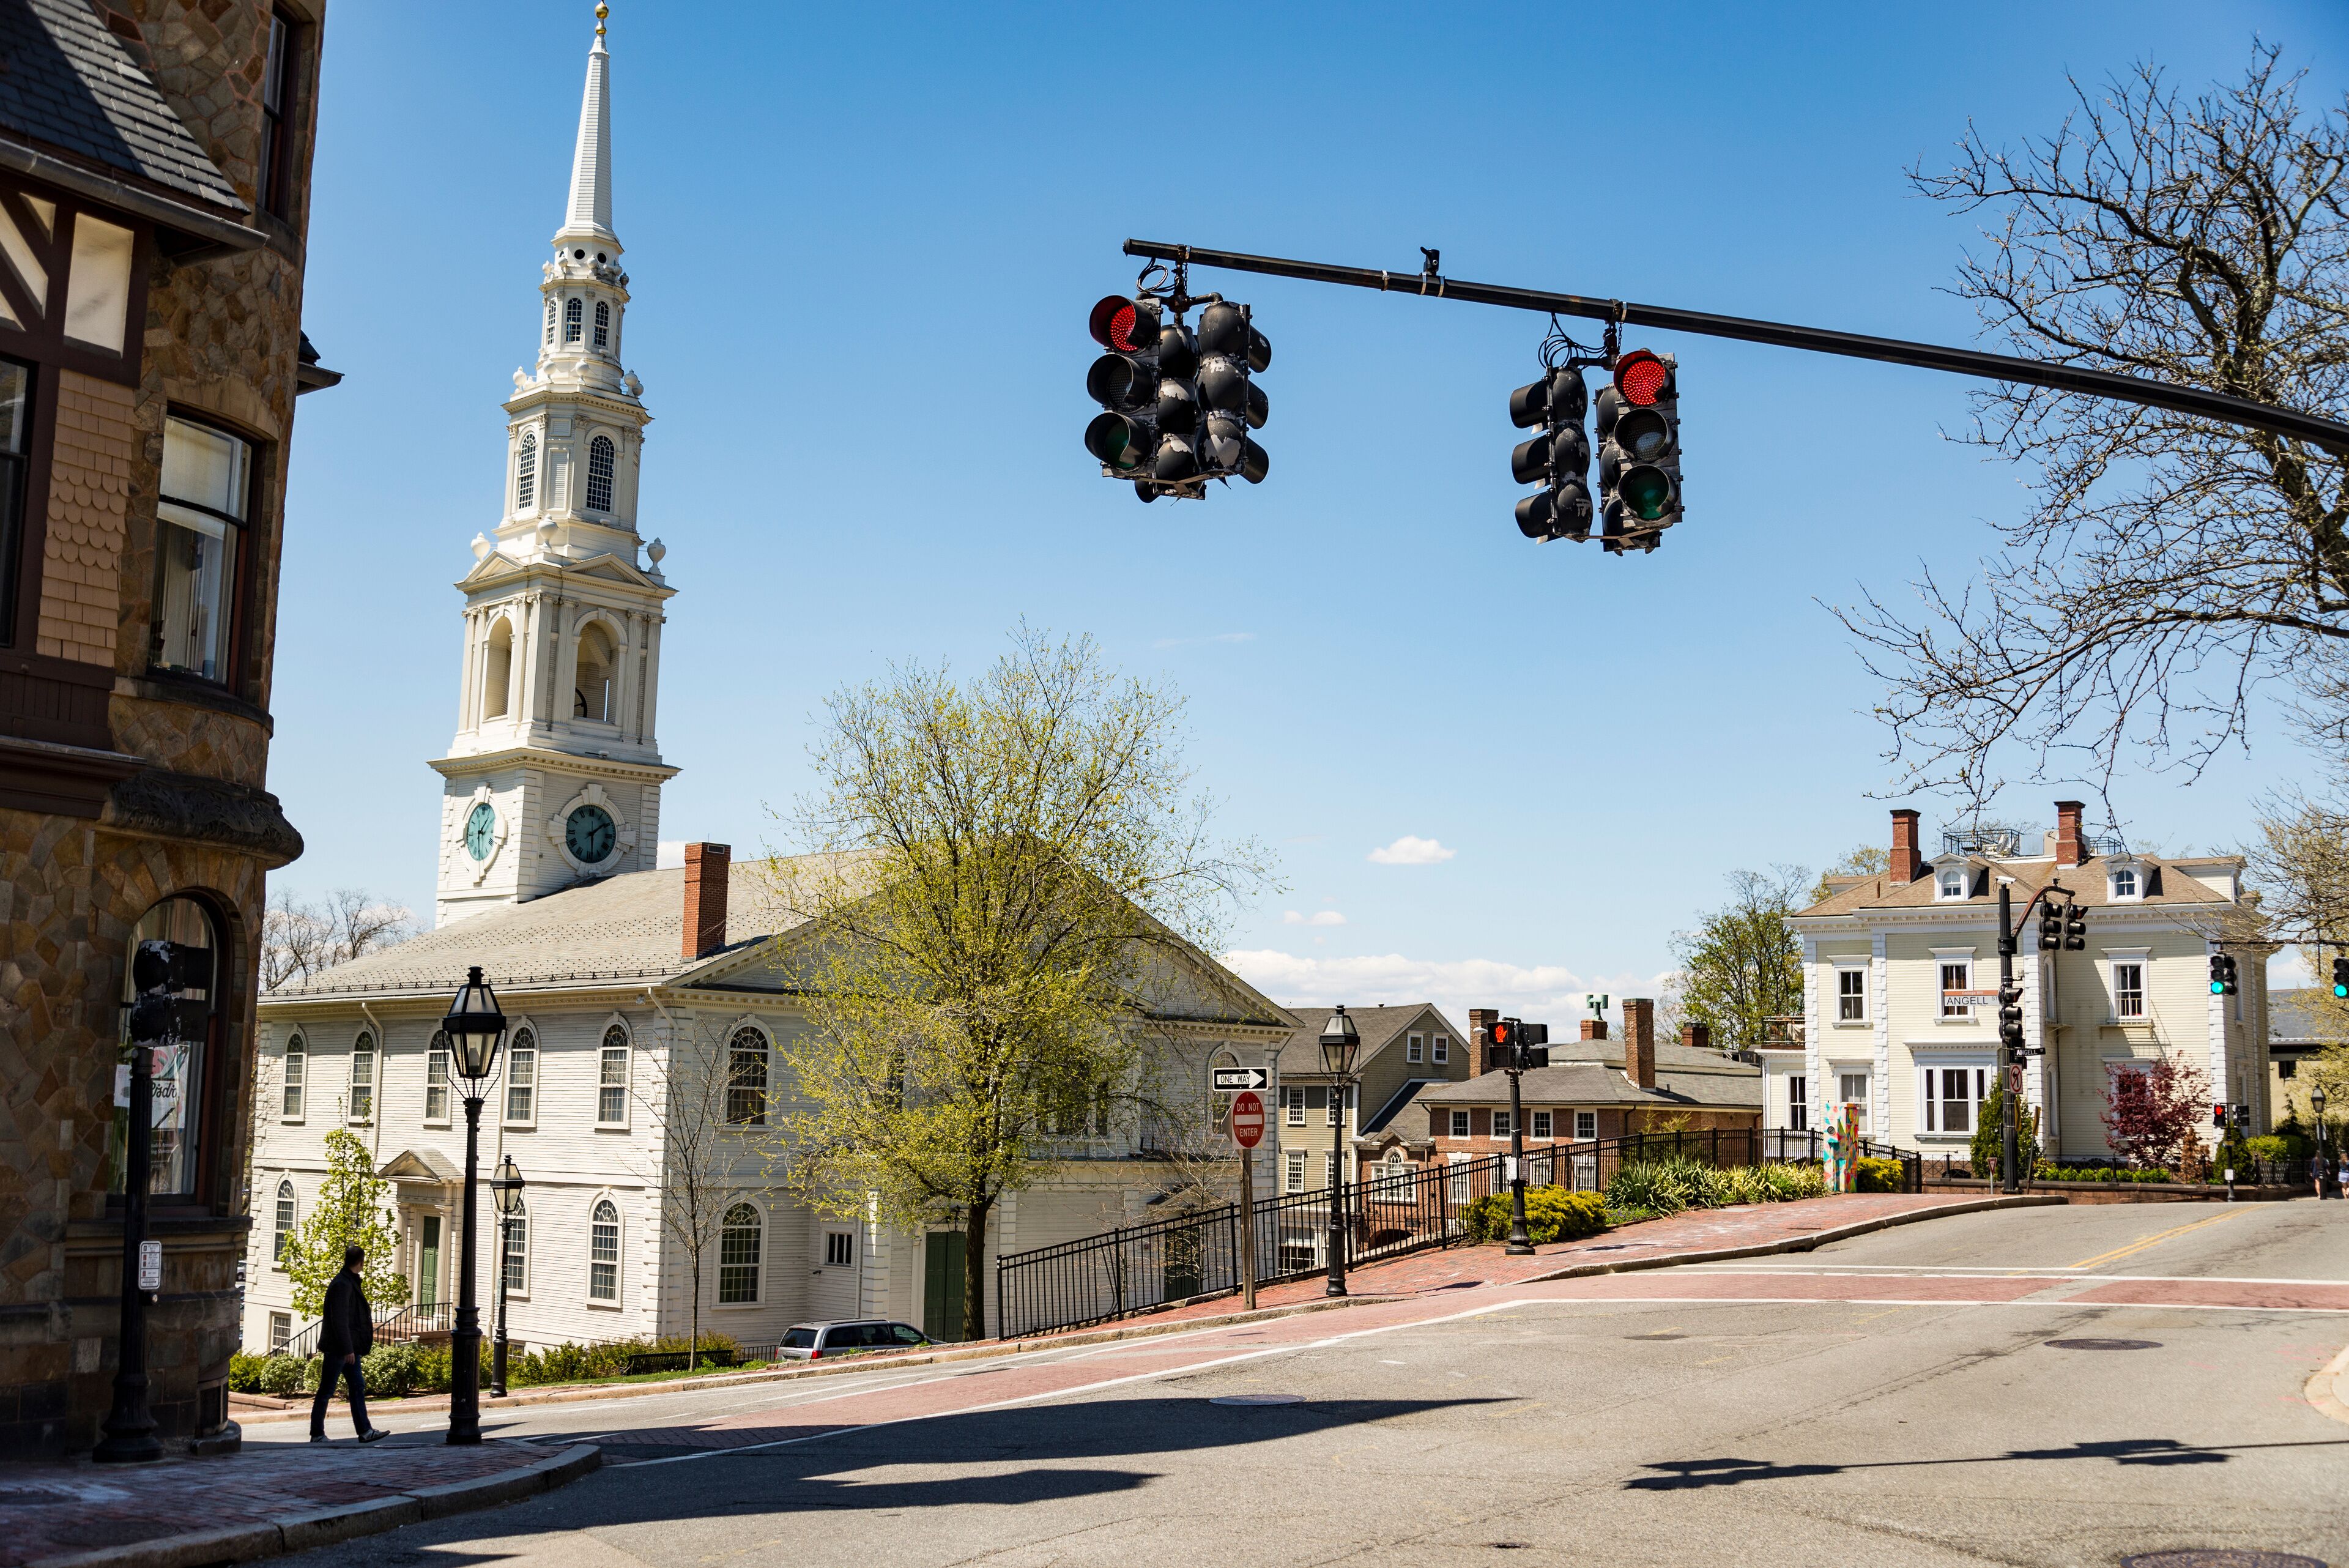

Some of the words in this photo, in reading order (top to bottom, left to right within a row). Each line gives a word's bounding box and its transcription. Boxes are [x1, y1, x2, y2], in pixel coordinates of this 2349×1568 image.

[1946, 997, 1988, 1005] ANGELL
[1220, 1075, 1233, 1083] ONE
[1237, 1103, 1245, 1112] DO
[1249, 1102, 1259, 1111] NOT
[1239, 1128, 1258, 1137] ENTER
